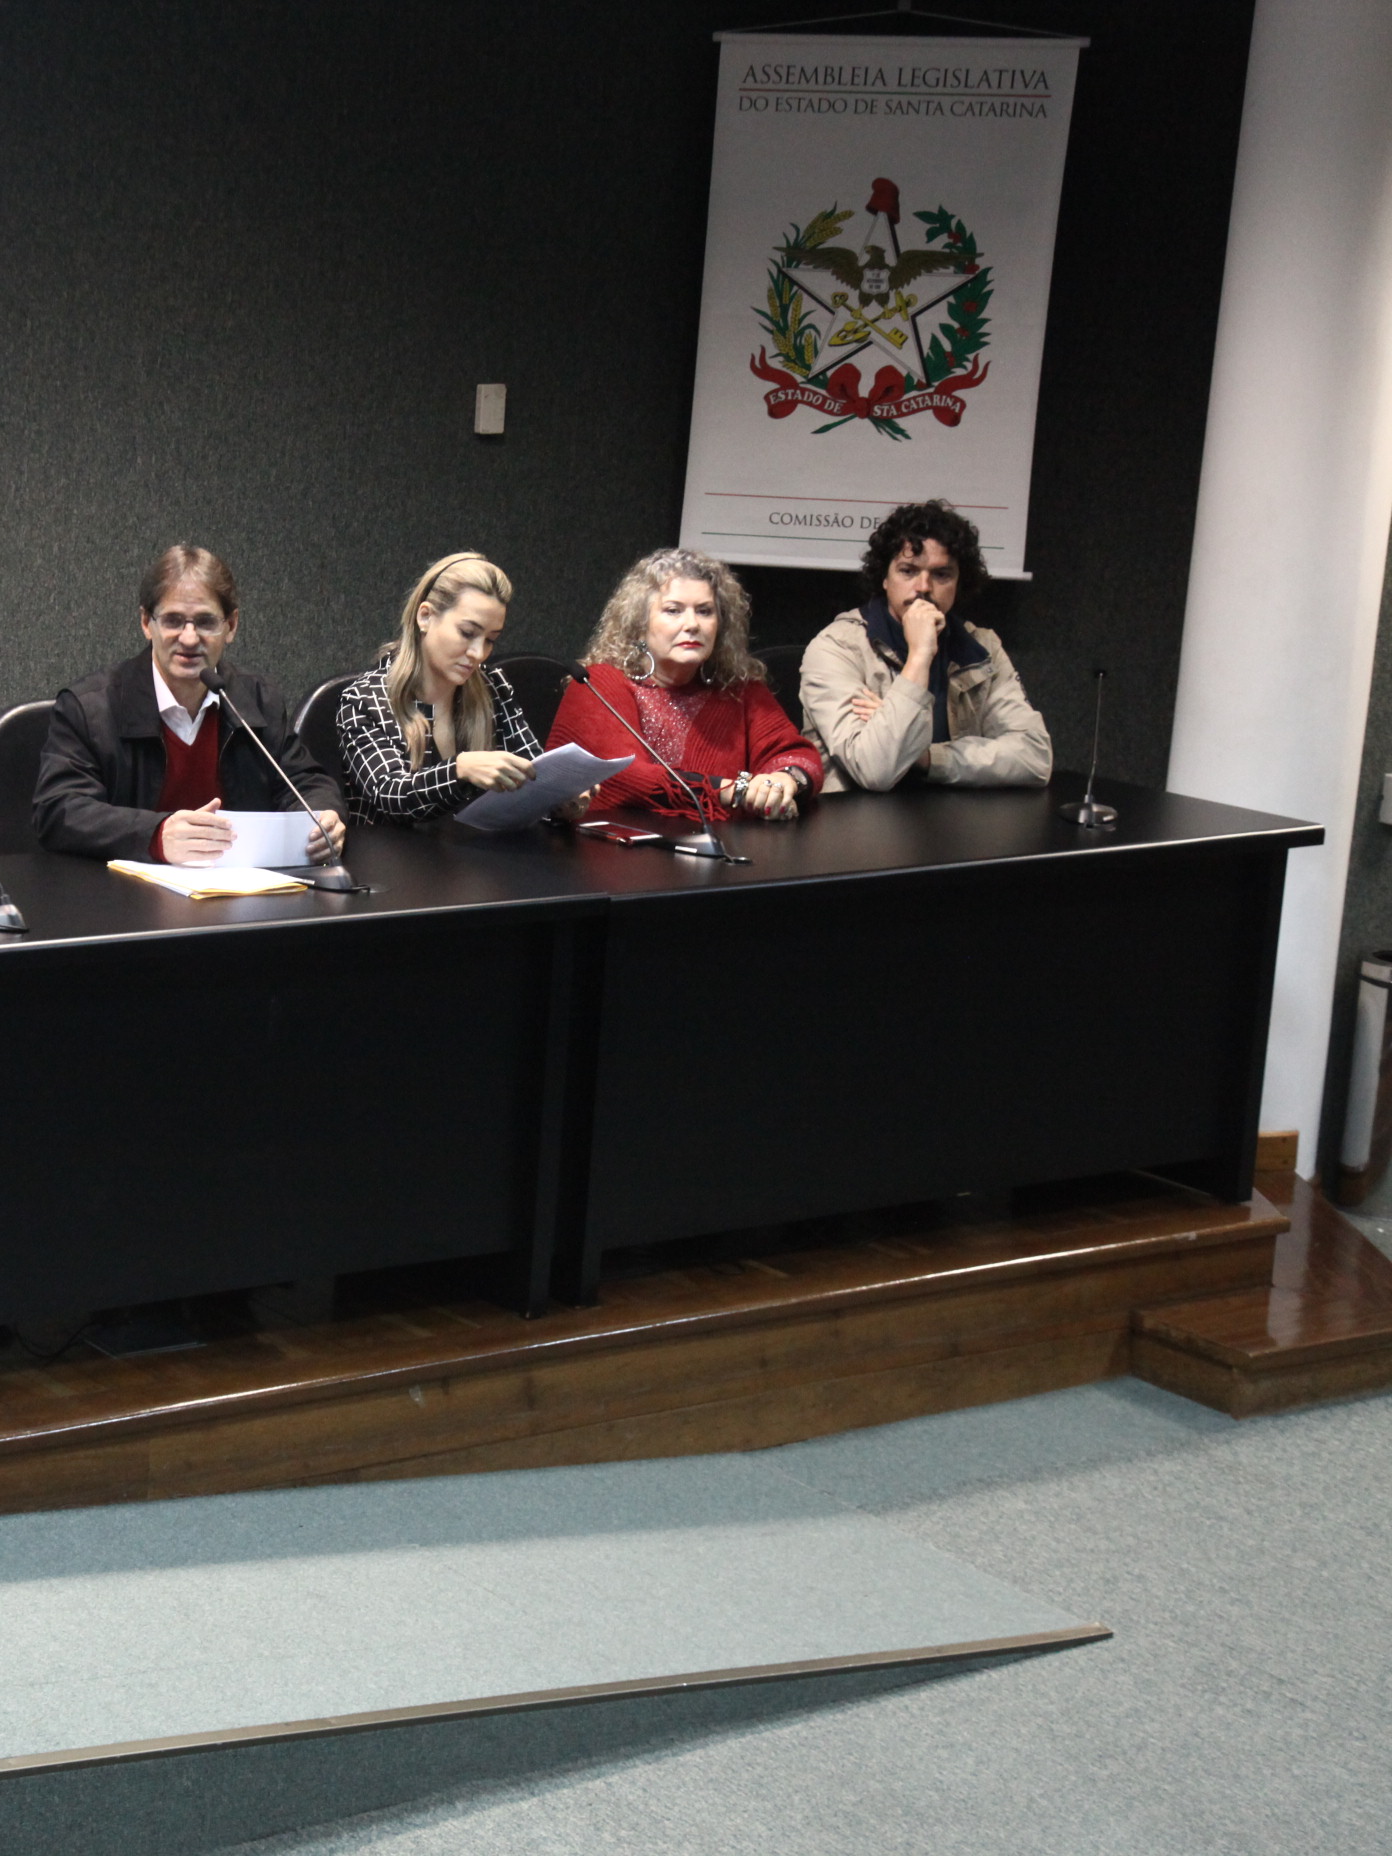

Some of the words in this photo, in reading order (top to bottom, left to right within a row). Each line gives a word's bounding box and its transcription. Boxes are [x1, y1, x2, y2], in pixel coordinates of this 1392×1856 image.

[741, 63, 888, 88] ASSEMBLEIA
[897, 67, 1050, 91] LEGISLATIVA
[738, 95, 769, 113] DO
[774, 96, 848, 115] ESTADO
[853, 98, 879, 115] DE
[883, 99, 945, 117] SANTA
[949, 100, 1048, 119] CATARINA
[769, 388, 823, 406] ESTADO
[824, 399, 845, 415] DE
[901, 393, 961, 413] CATARINA
[768, 511, 854, 529] COMISSÃO
[860, 516, 881, 530] DE
